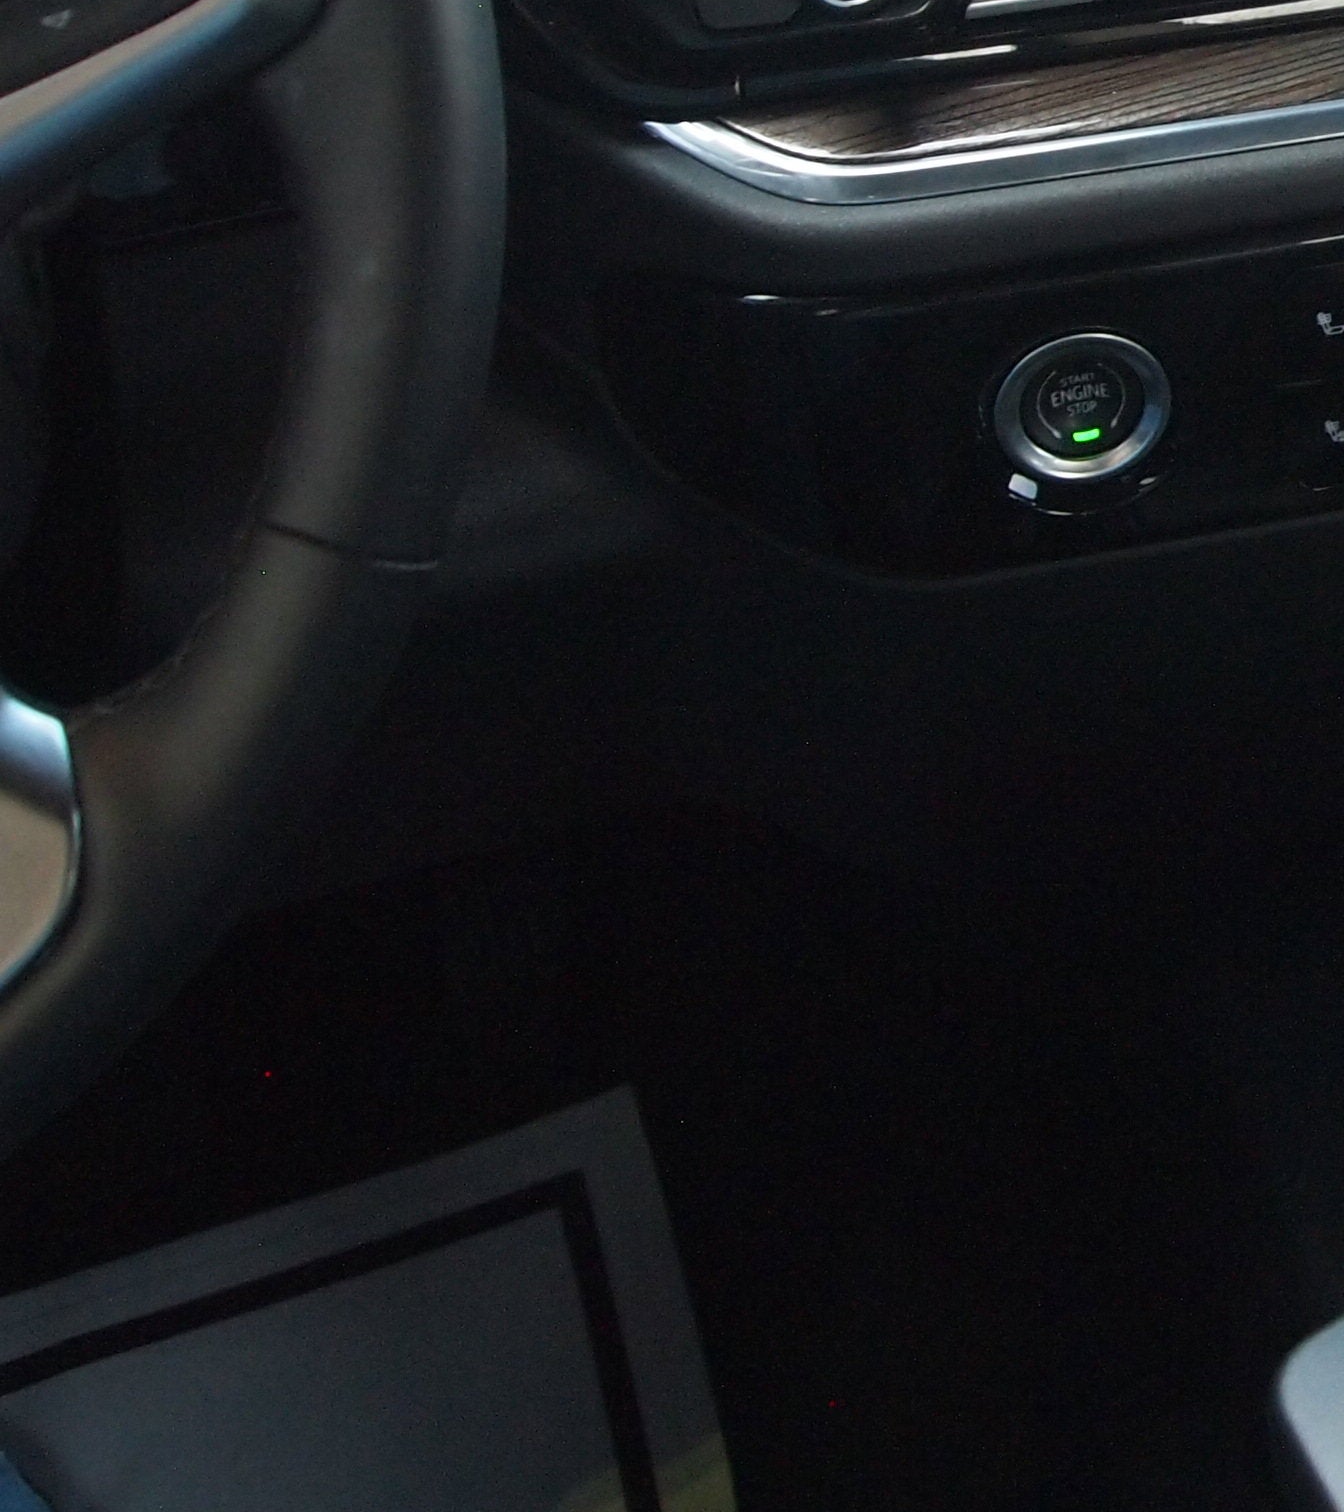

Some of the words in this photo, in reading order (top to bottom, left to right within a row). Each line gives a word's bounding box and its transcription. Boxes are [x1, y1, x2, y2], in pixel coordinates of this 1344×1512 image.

[1060, 373, 1095, 387] START
[1051, 383, 1111, 408] ENGINE
[1067, 401, 1098, 416] STOP
